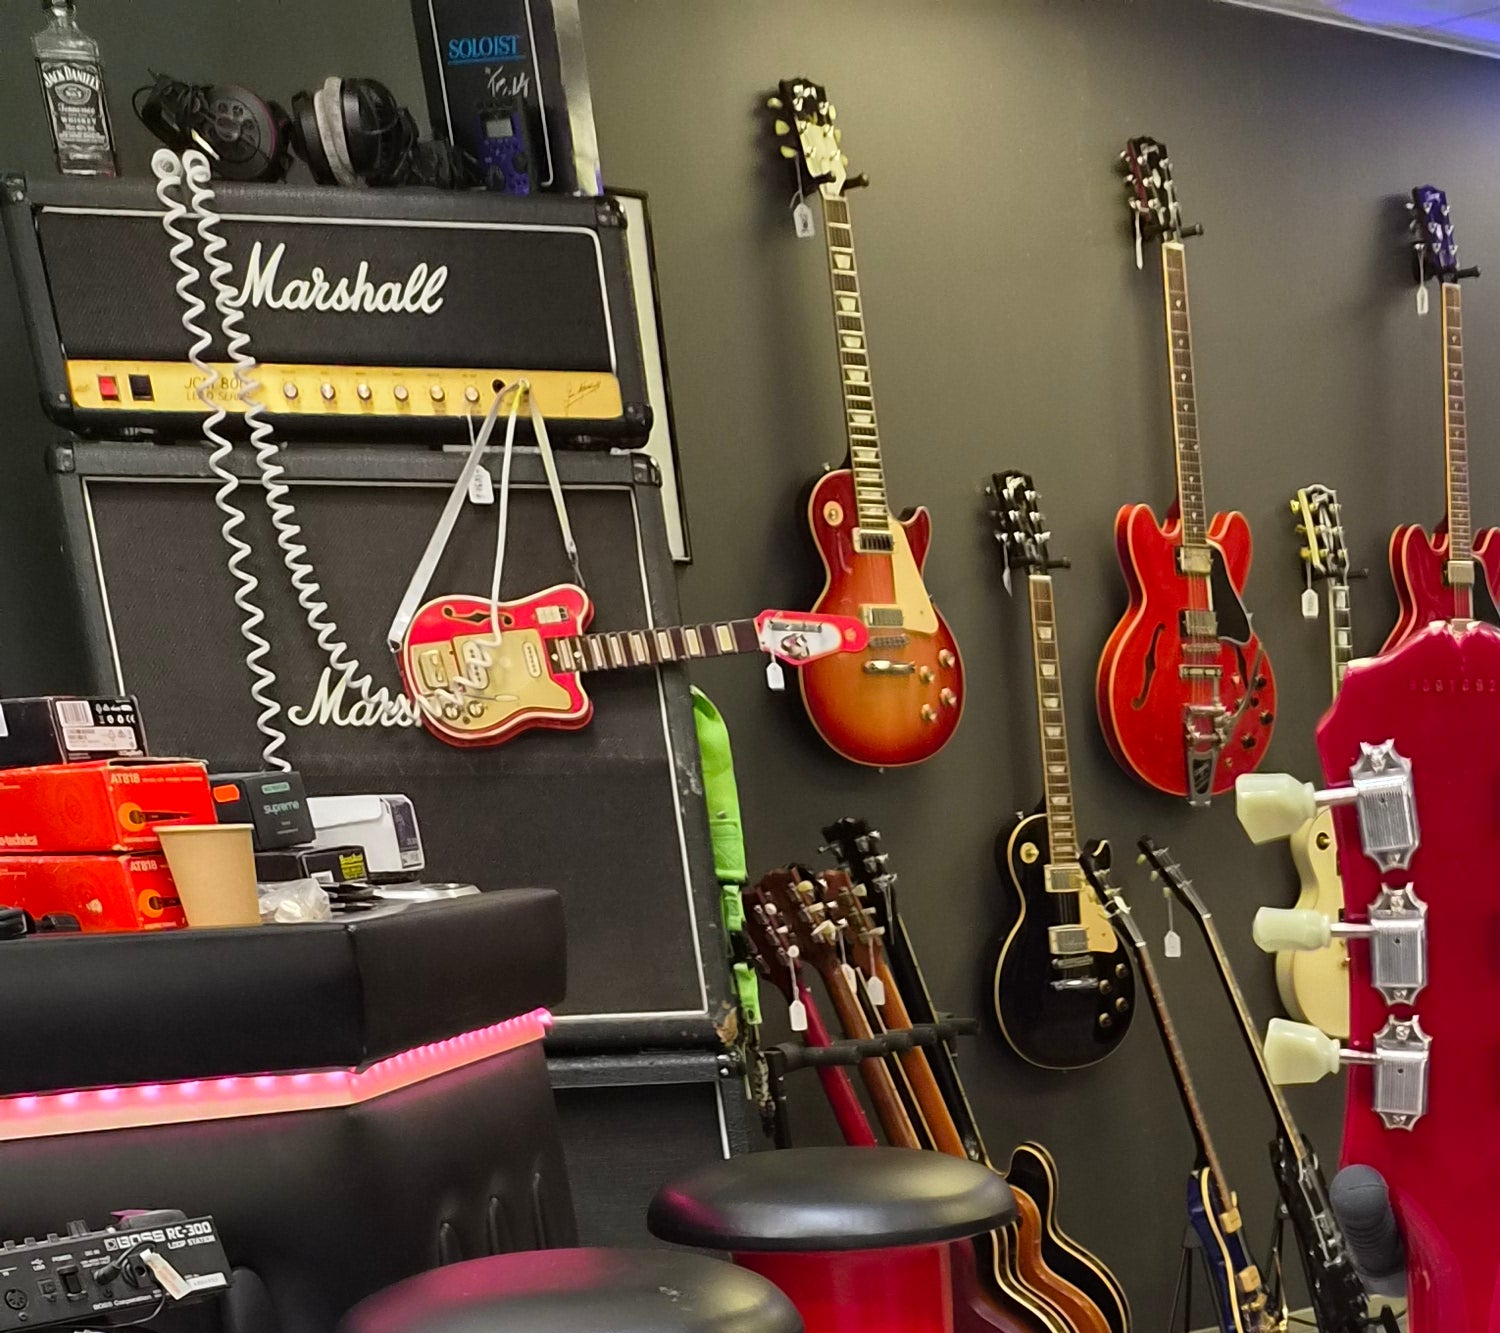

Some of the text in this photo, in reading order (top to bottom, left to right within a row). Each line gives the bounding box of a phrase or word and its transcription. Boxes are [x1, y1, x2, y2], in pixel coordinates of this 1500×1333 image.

[448, 35, 520, 59] SOLOIST
[223, 241, 448, 314] Marshall
[287, 667, 423, 728] Mars
[110, 773, 141, 785] AT818
[263, 800, 300, 815] supreme
[129, 860, 158, 872] AT818
[165, 1221, 212, 1241] RC-300
[168, 1241, 186, 1250] LOOP
